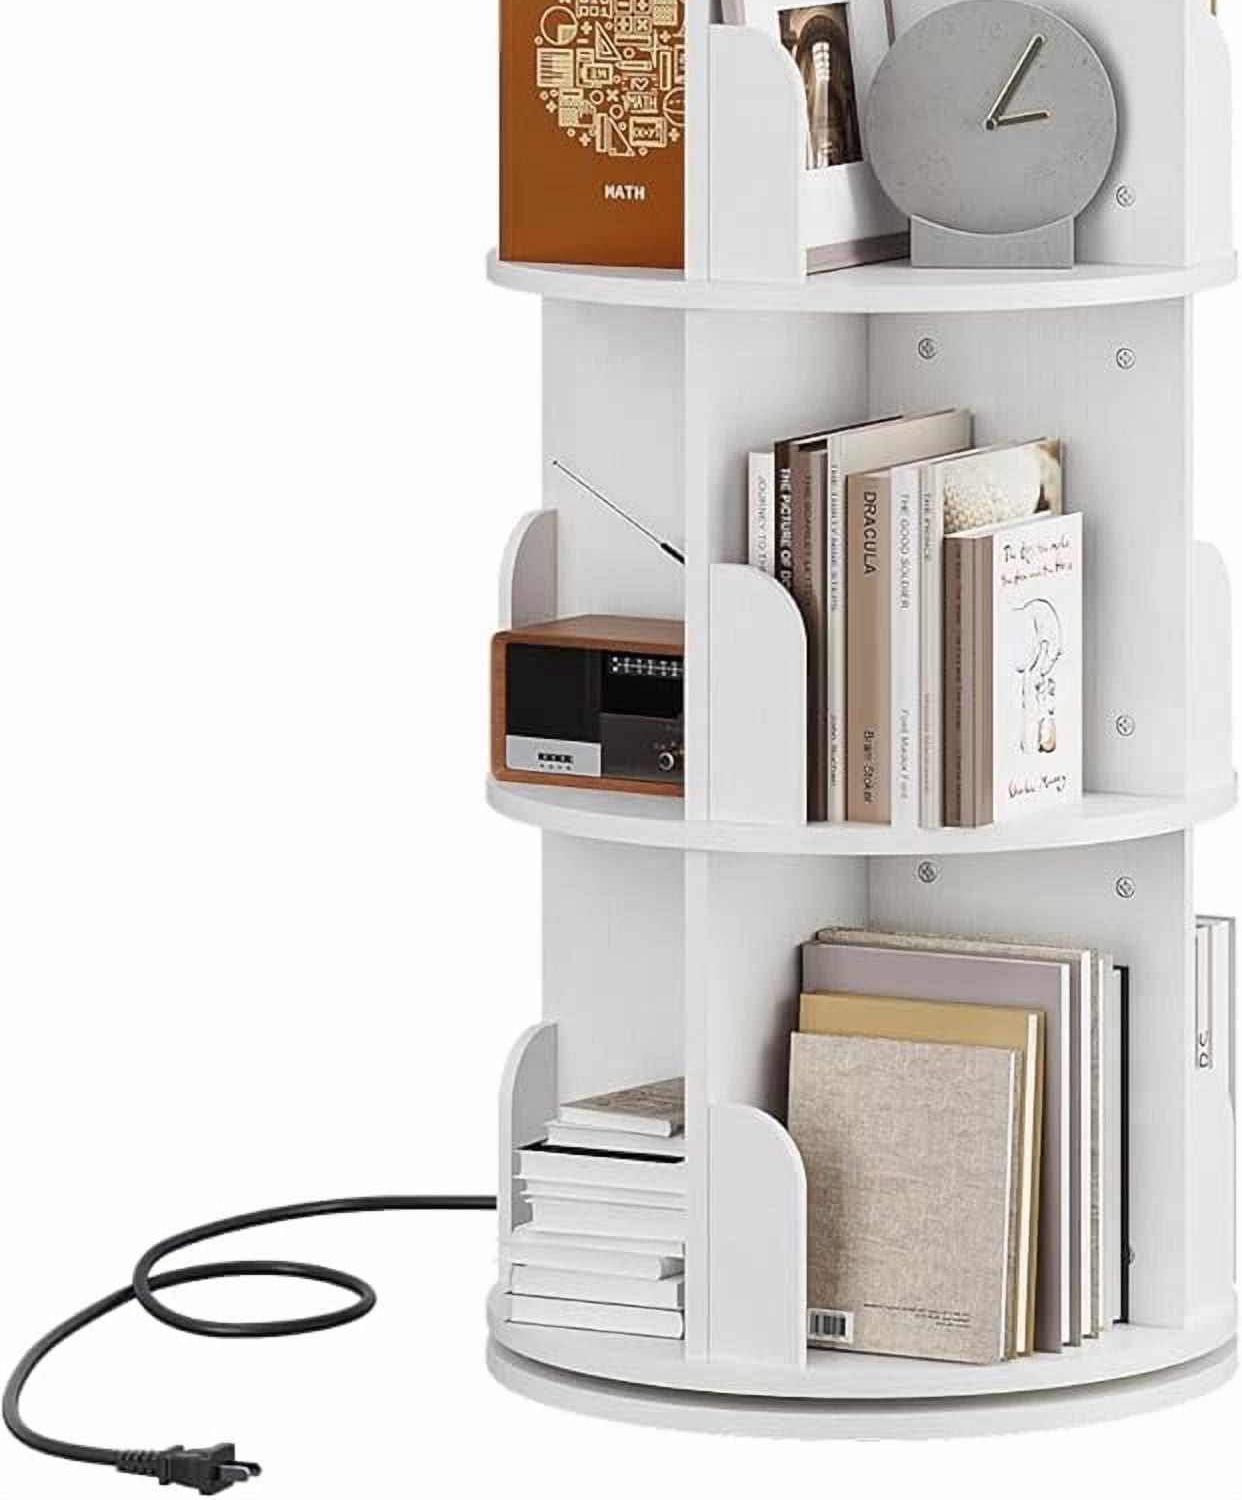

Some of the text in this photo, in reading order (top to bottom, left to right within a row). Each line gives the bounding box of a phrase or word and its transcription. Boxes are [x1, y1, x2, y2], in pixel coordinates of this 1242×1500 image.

[604, 184, 645, 201] MATH
[780, 468, 792, 491] THE
[757, 476, 768, 529] JOURNEY
[900, 493, 911, 517] THE
[780, 494, 792, 548] PICTURE
[863, 491, 877, 575] DRACULA
[757, 535, 768, 549] TO
[780, 549, 792, 567] OF
[900, 557, 911, 609] SOLDIER
[863, 764, 875, 804] Stoker
